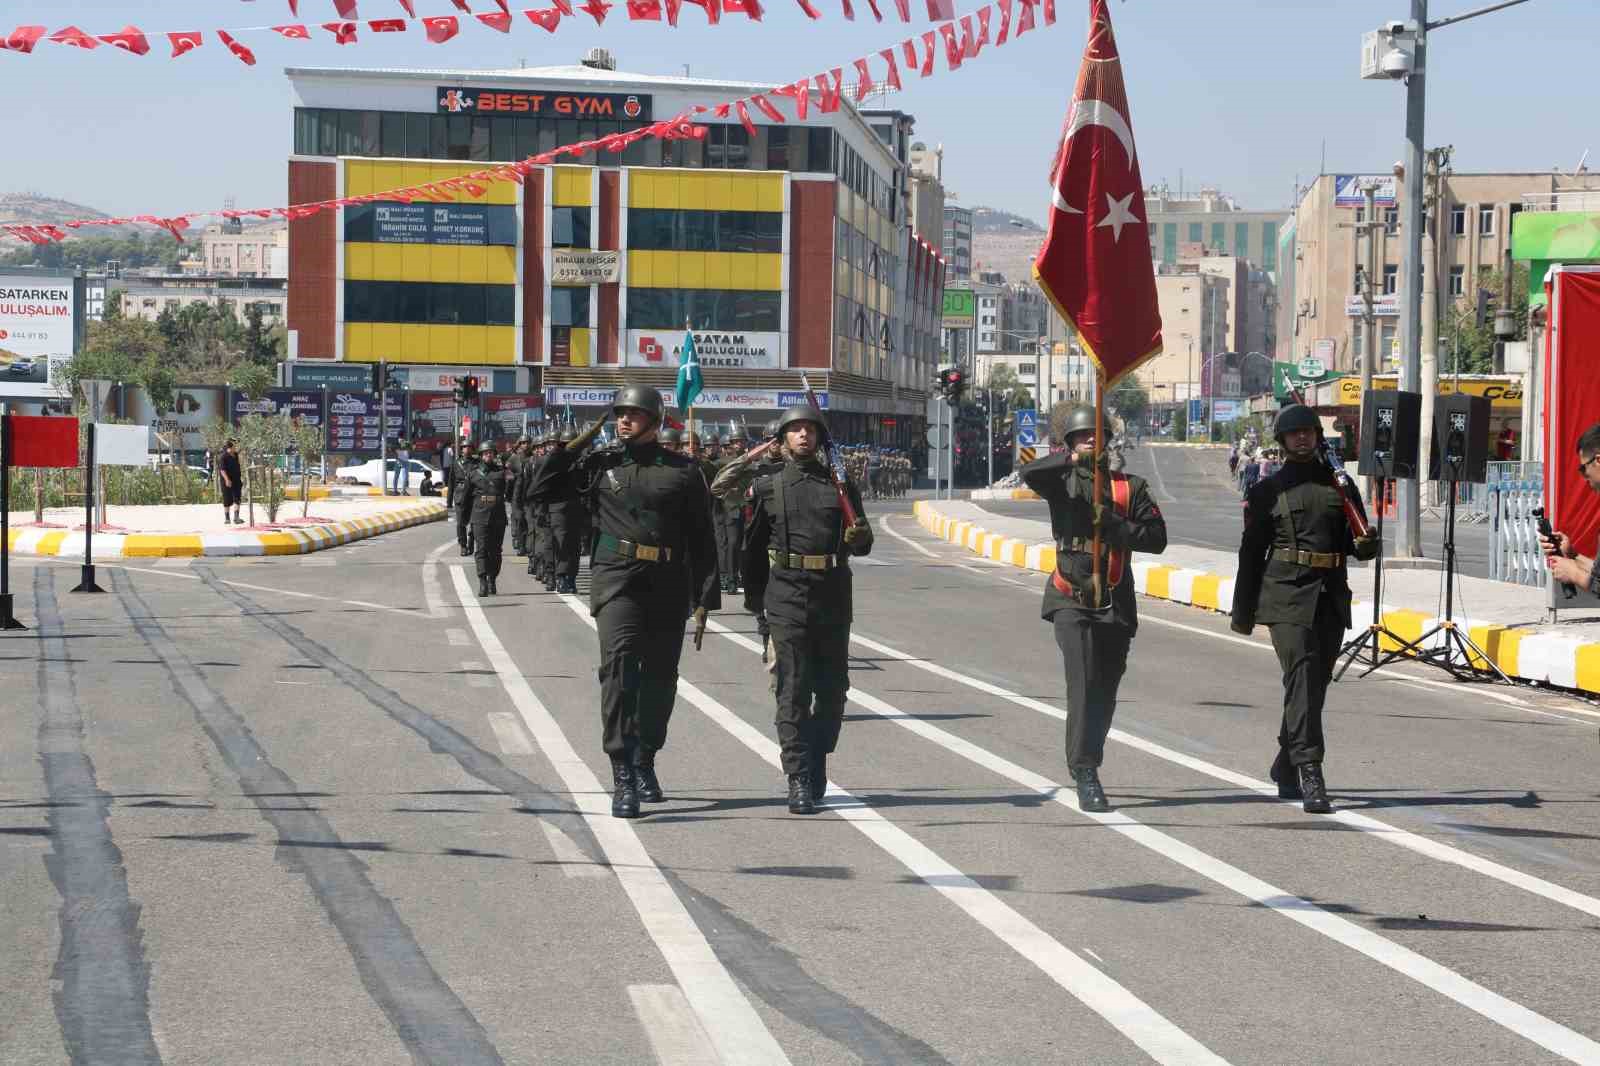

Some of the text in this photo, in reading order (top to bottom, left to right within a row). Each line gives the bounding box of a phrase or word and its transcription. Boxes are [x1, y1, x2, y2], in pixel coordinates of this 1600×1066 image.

[477, 93, 613, 114] BEST GYM
[0, 289, 68, 301] SATARKEN
[693, 335, 744, 345] SATAM
